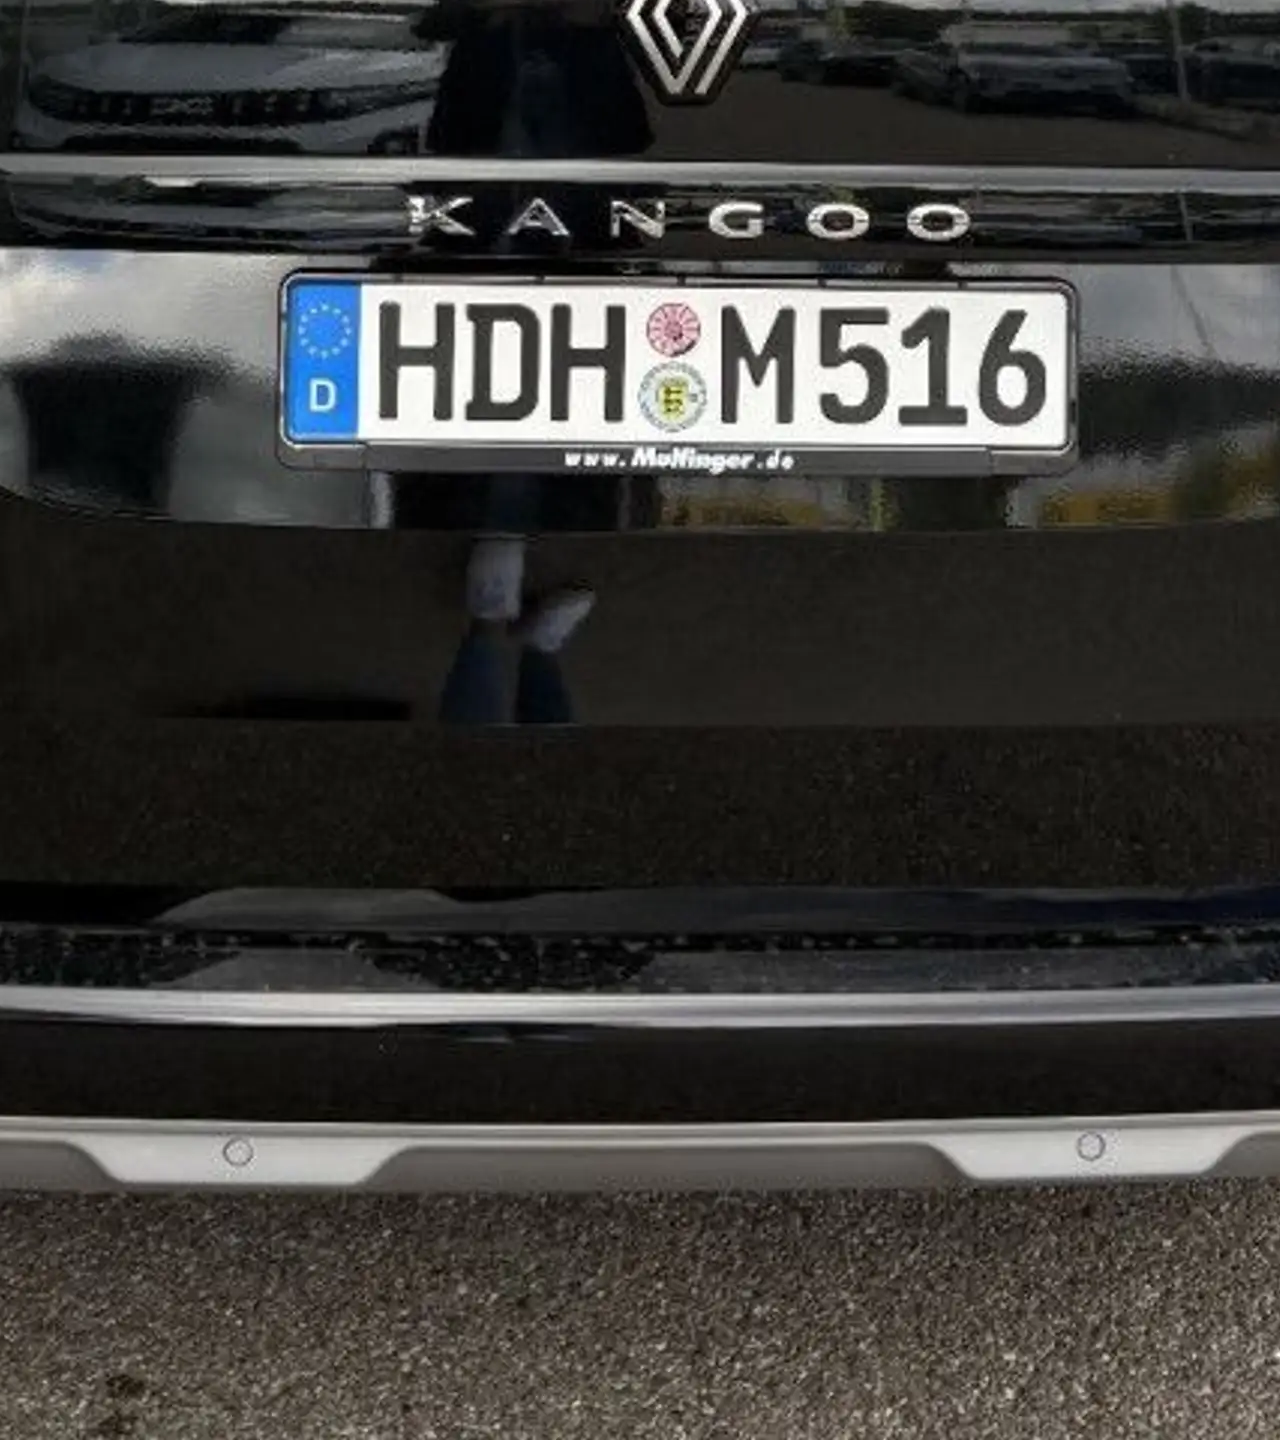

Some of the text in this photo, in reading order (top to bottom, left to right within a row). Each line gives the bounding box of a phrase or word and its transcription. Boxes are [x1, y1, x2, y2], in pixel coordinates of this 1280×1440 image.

[407, 196, 971, 240] KANGOO
[378, 300, 626, 422] HDH
[309, 378, 337, 412] D
